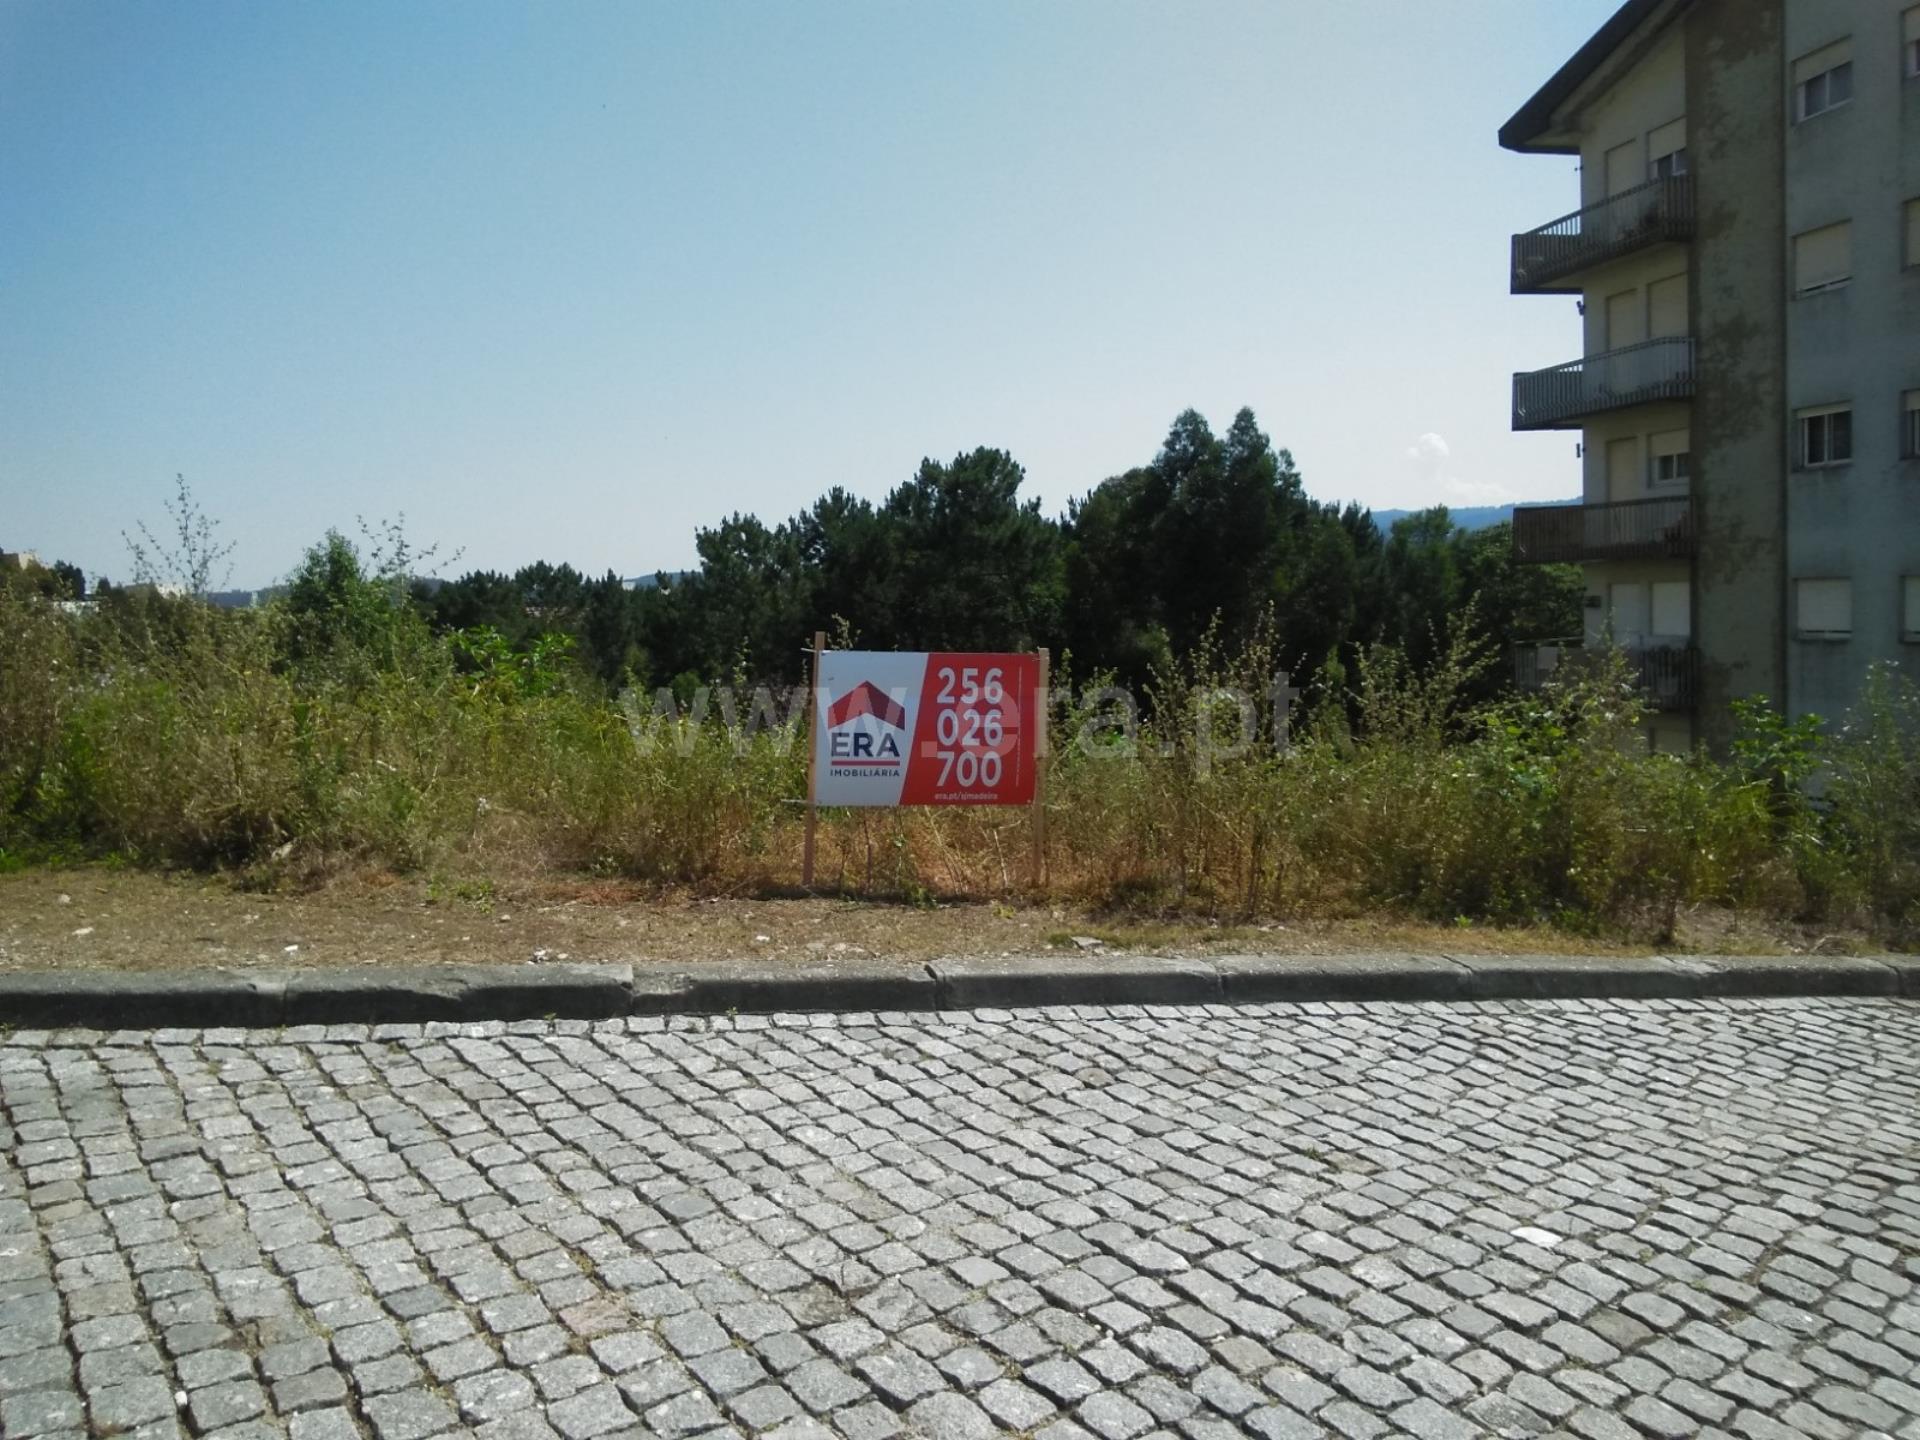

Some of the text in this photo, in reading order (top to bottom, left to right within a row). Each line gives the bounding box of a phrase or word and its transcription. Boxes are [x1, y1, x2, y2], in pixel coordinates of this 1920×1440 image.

[937, 667, 1003, 704] 256
[831, 732, 900, 757] ERA
[937, 709, 1003, 746] 026
[936, 751, 1002, 787] 700
